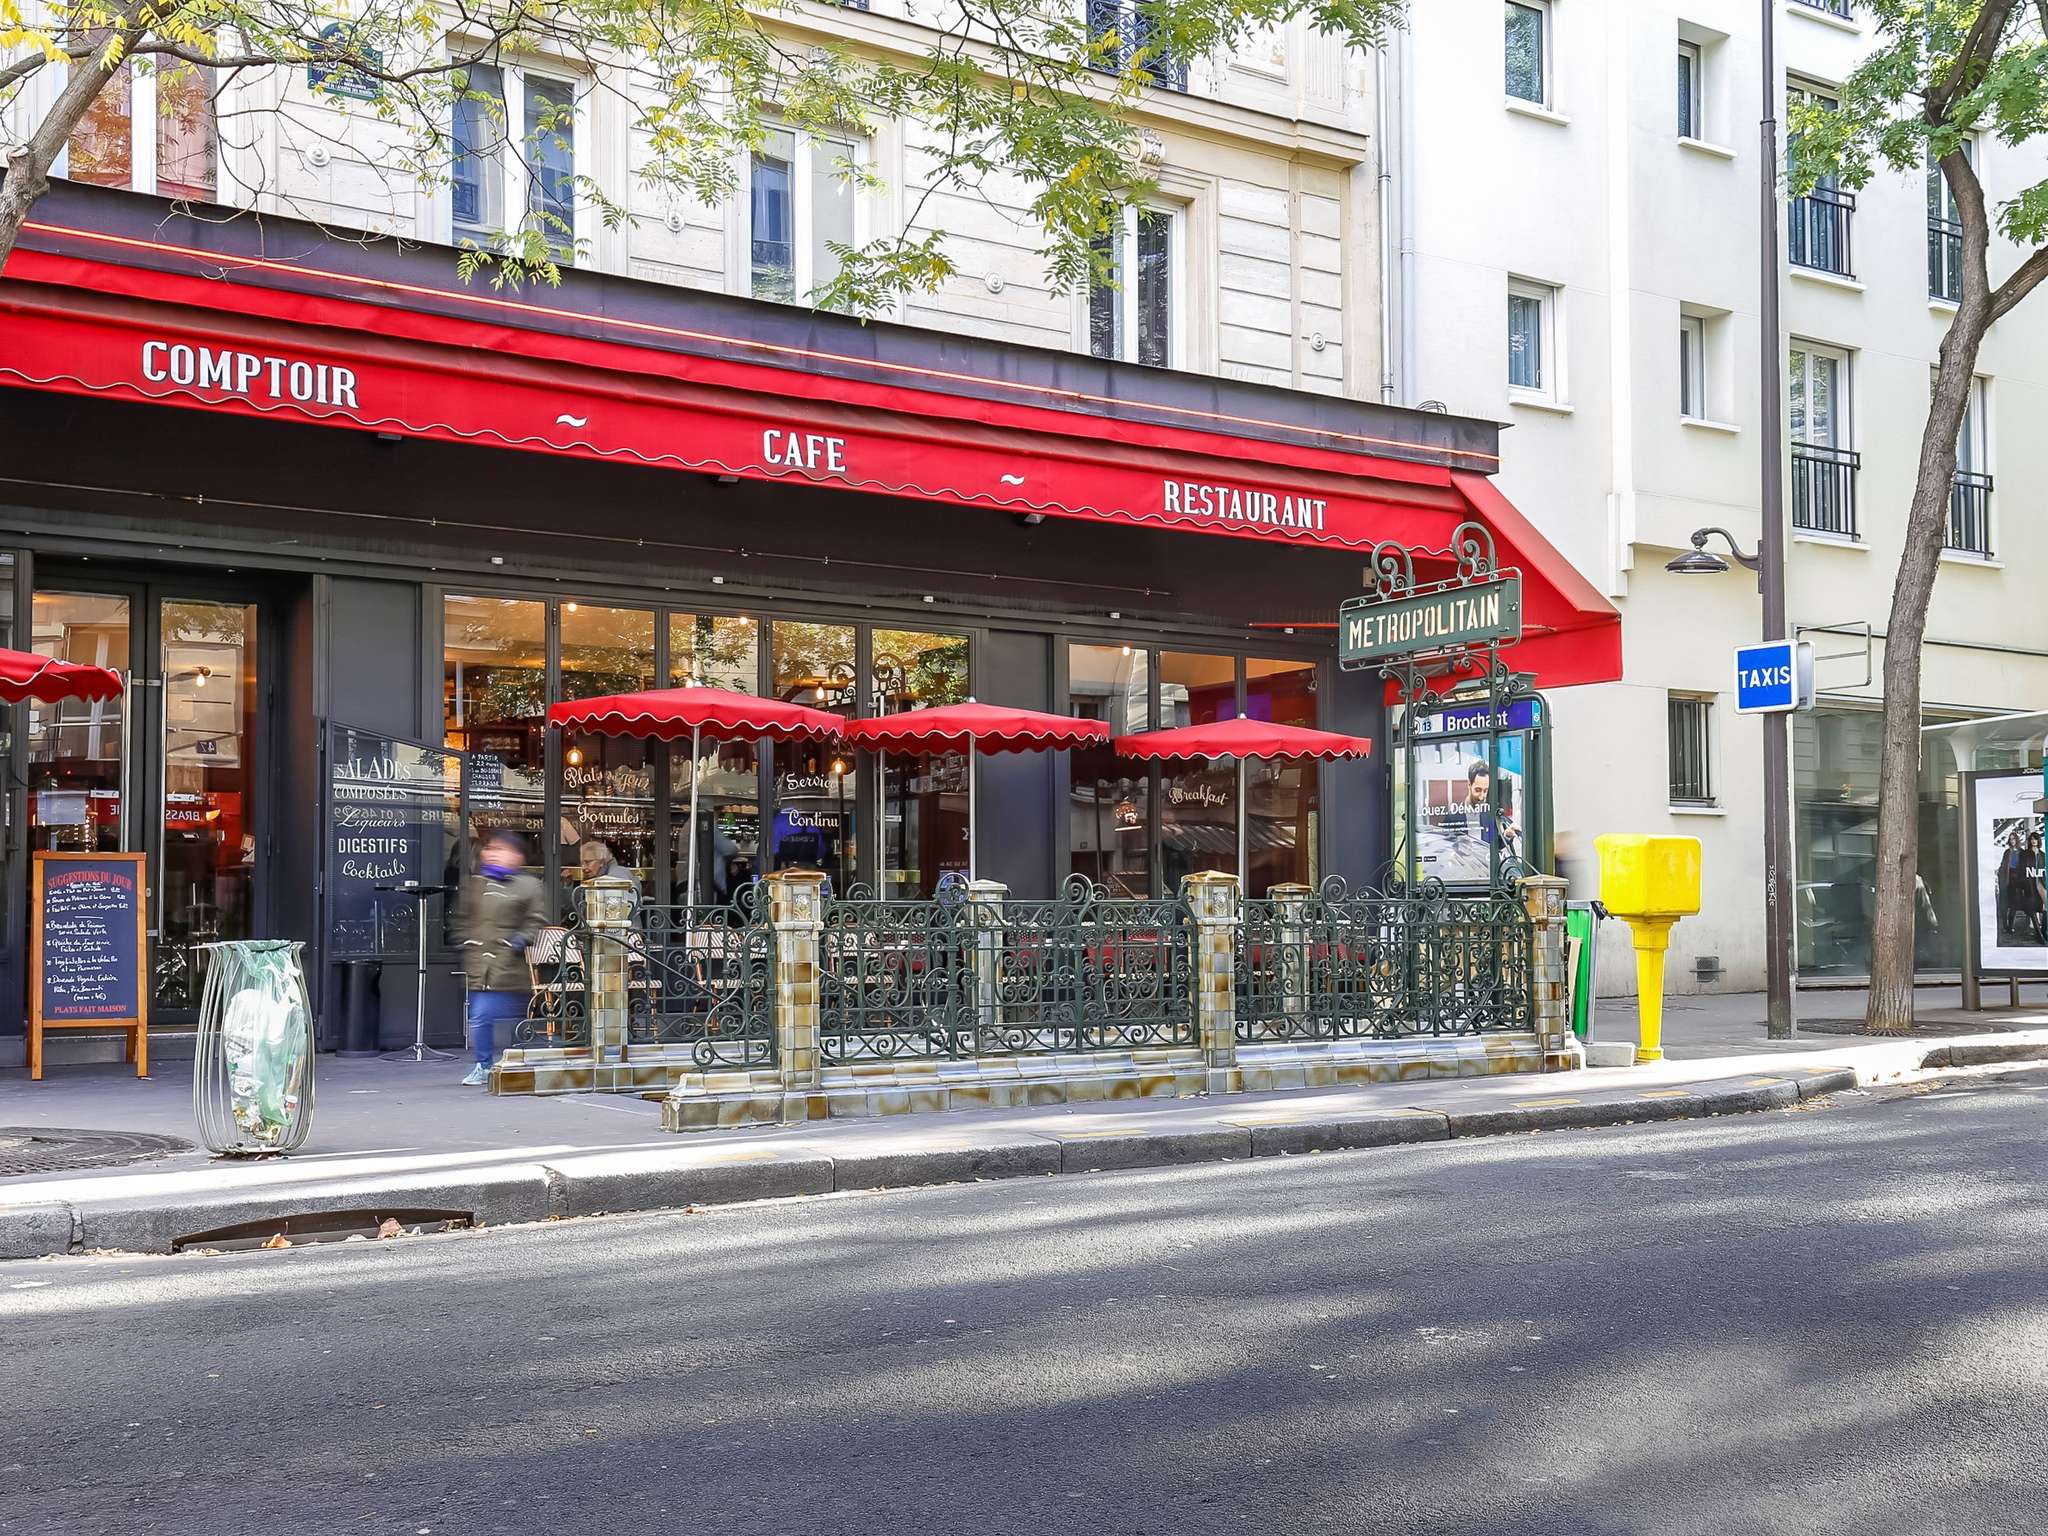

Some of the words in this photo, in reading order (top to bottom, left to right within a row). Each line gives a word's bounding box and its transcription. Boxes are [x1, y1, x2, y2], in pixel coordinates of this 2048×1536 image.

[142, 340, 359, 409] COMPTOIR
[763, 429, 846, 472] CAFE
[1163, 480, 1327, 531] RESTAURANT
[1349, 593, 1500, 650] METROPOLITAIN
[1739, 666, 1791, 689] TAXIS
[1422, 721, 1432, 732] 13
[335, 756, 411, 780] SALADES
[563, 767, 603, 788] Plats
[334, 784, 407, 800] COMPOSÉES
[1168, 783, 1229, 807] Breakfast
[336, 804, 406, 834] Liqueurs
[577, 802, 639, 824] Formules
[789, 809, 839, 827] Continu
[338, 838, 407, 854] DIGESTIFS
[342, 858, 406, 879] Cocktails
[47, 870, 100, 890] SUGGESTIONS
[101, 871, 111, 883] DU
[111, 874, 133, 892] JOUR
[54, 1006, 79, 1014] PLATS
[97, 1004, 127, 1013] MAISON
